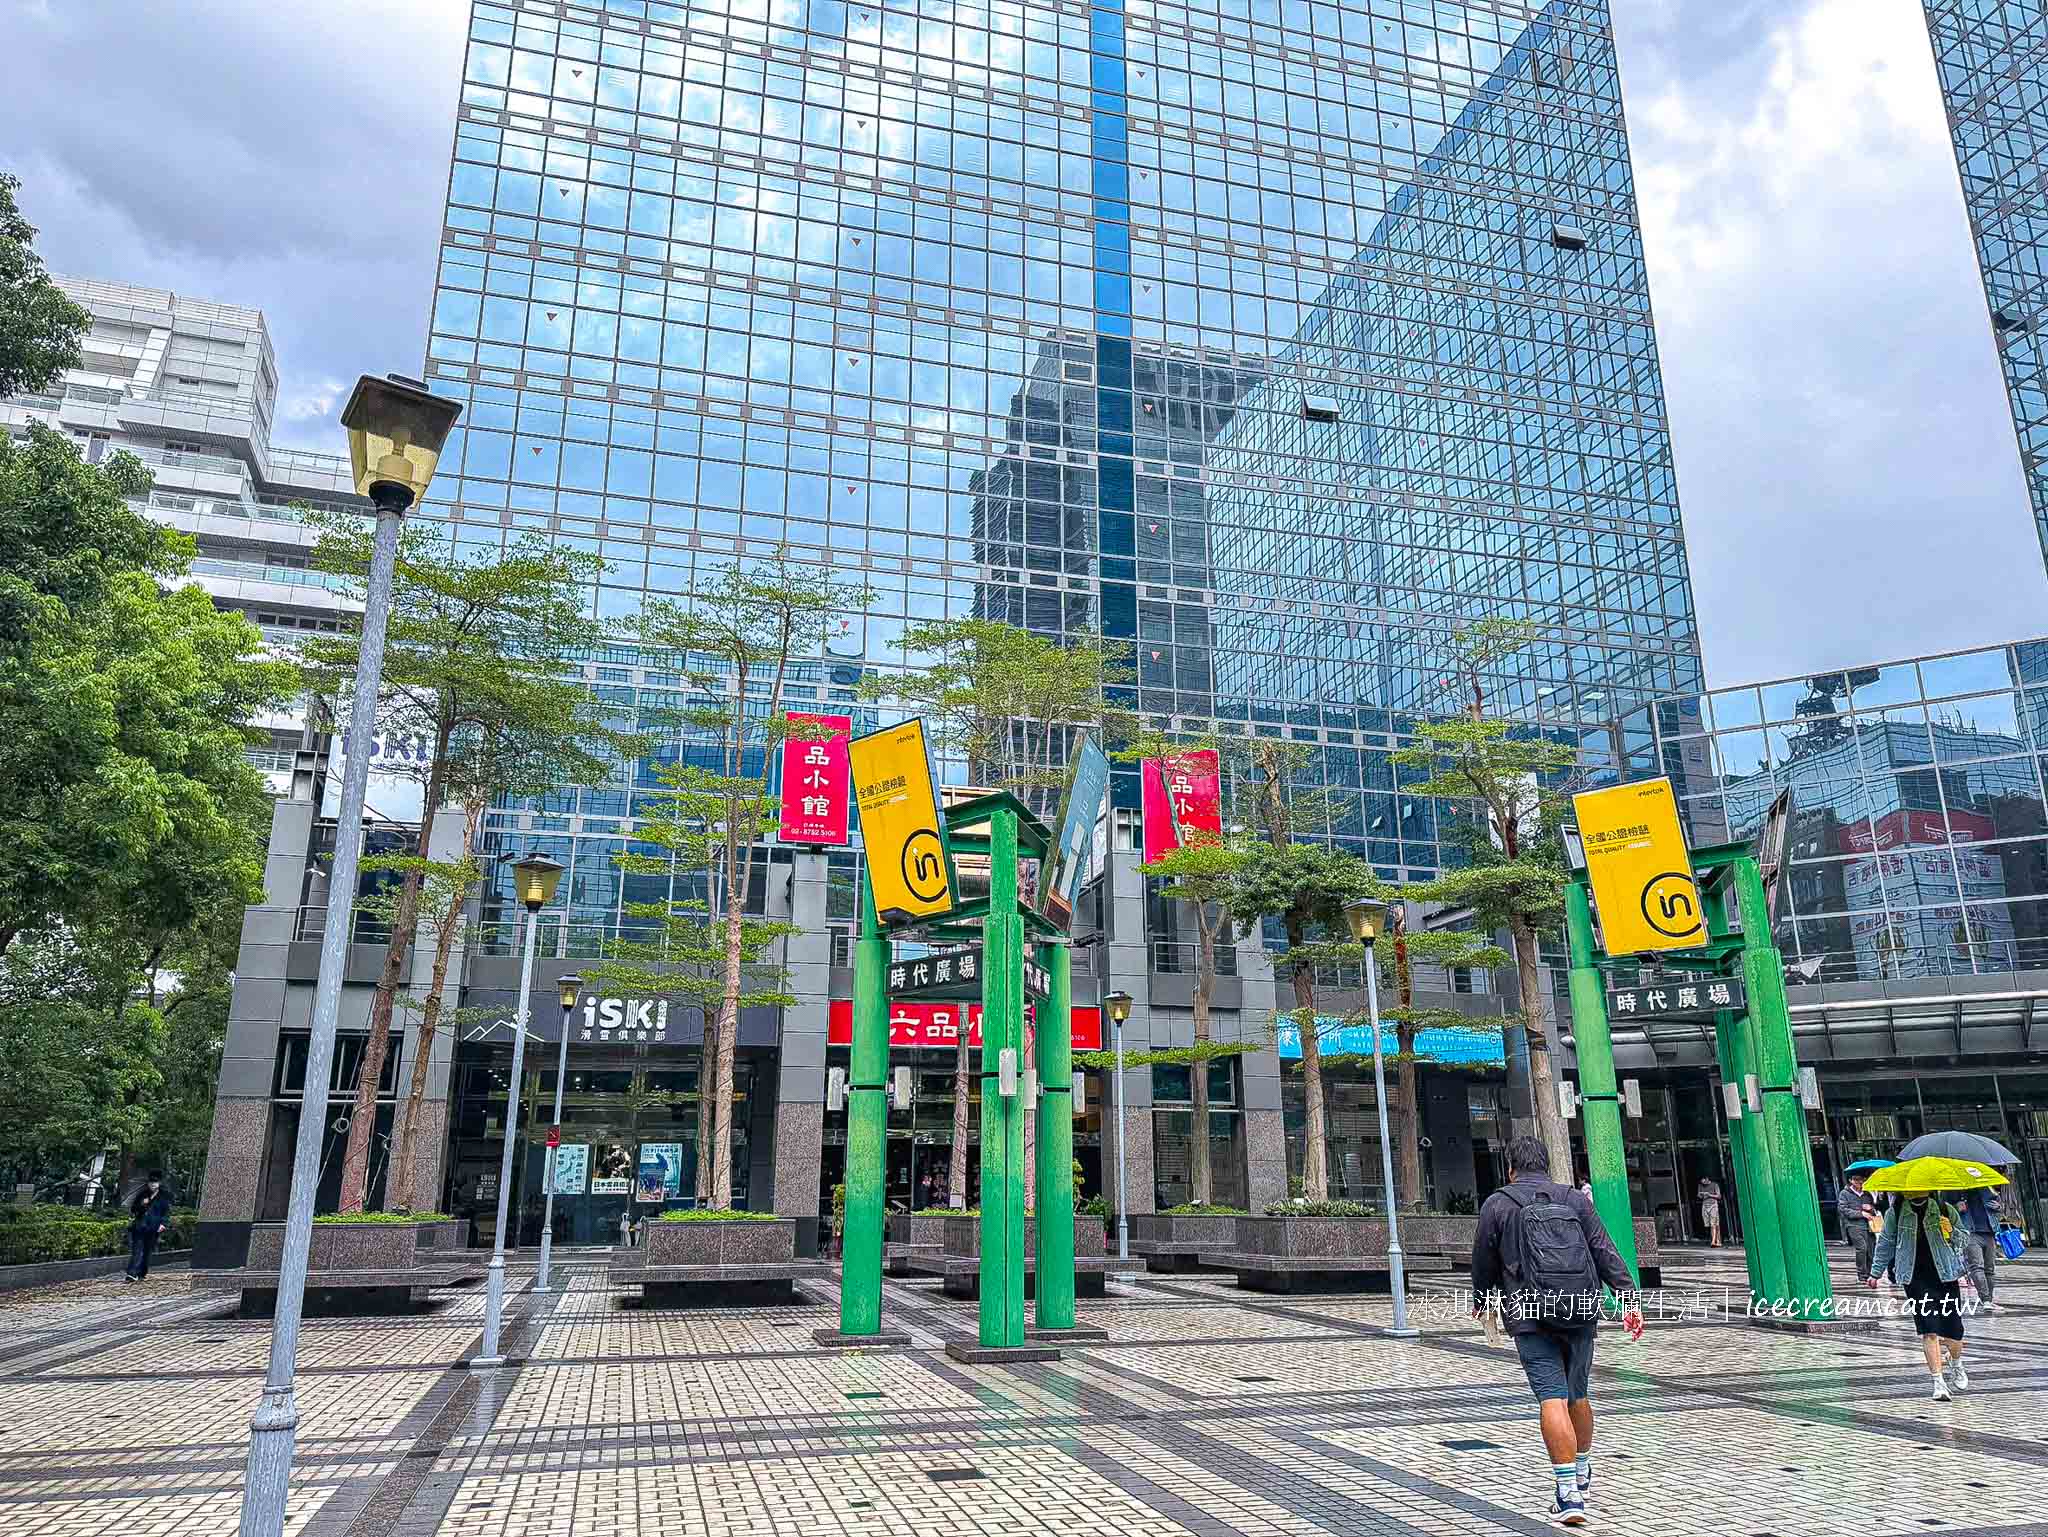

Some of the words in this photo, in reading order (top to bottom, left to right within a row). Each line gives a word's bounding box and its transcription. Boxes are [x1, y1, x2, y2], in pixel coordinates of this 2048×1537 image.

[891, 955, 975, 989] 時代廣場
[1616, 984, 1730, 1013] 時代廣場
[580, 1029, 666, 1041] 滑雪俱樂部
